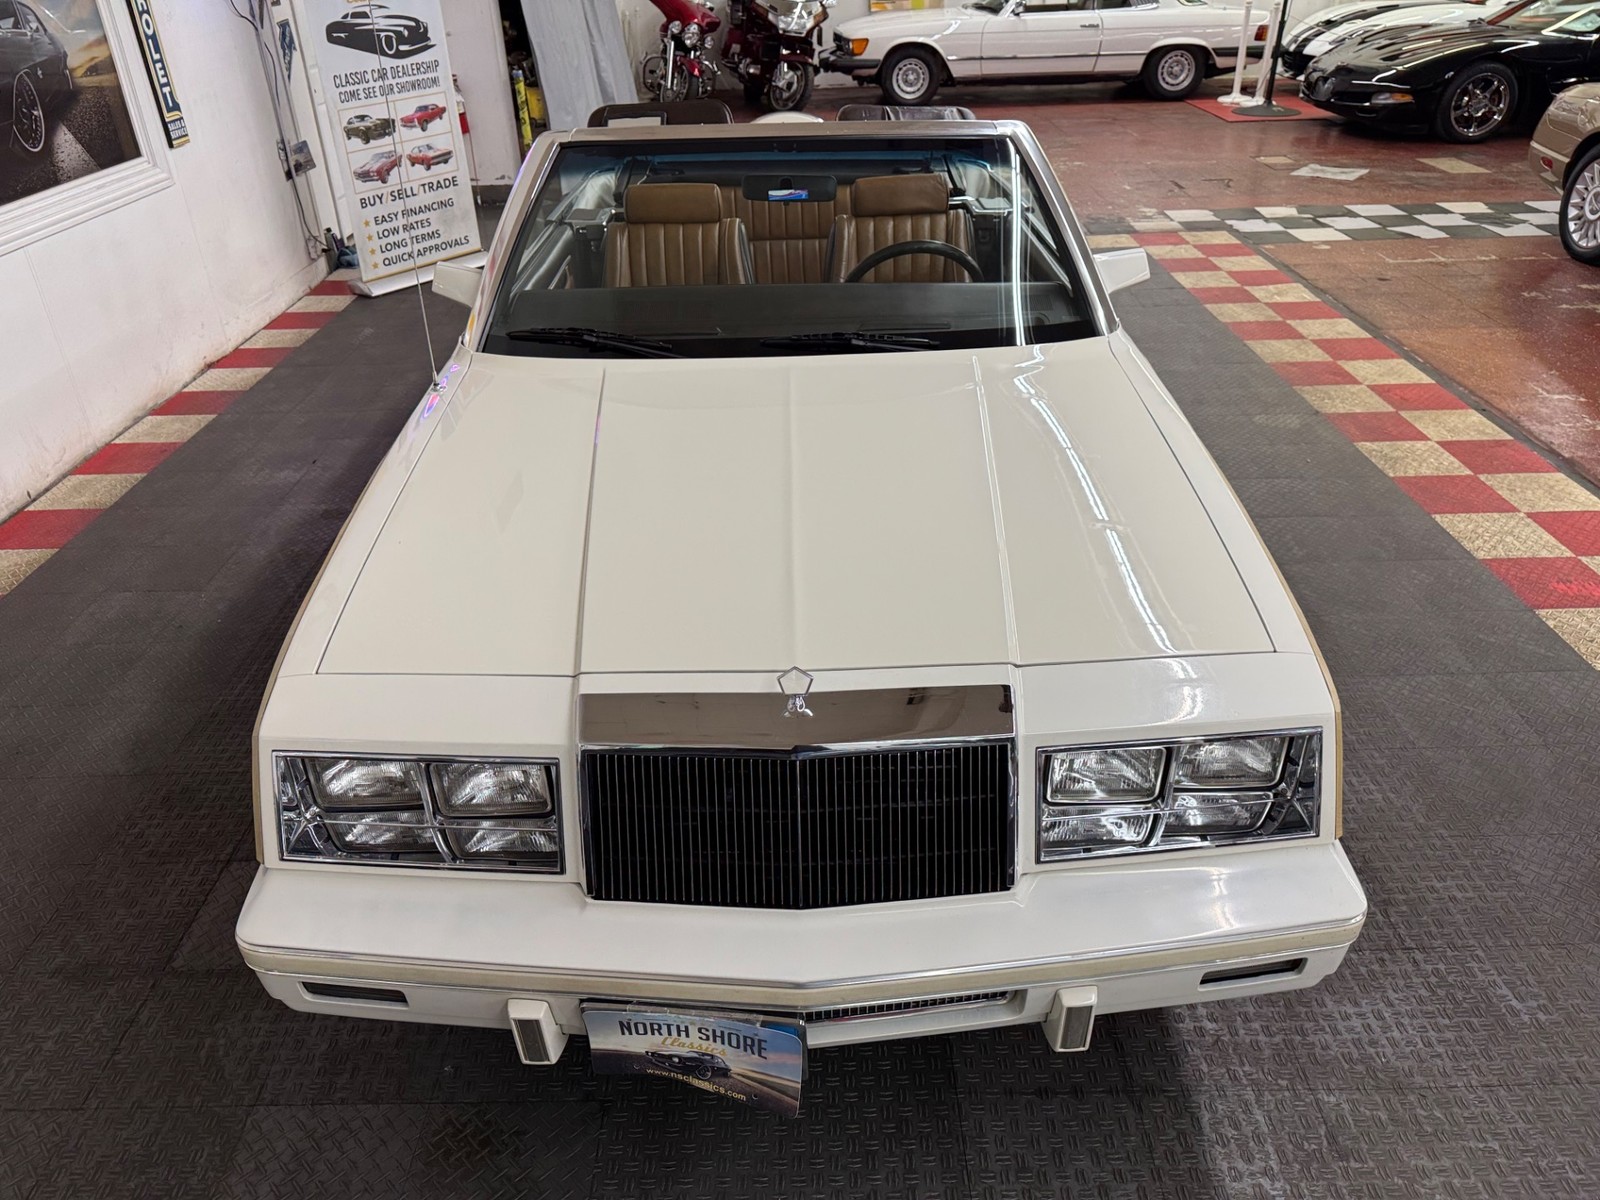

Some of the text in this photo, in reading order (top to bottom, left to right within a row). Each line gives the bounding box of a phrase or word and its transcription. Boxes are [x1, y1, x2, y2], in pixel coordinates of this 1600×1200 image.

[333, 59, 440, 88] CLASSIC CAR DEALERSHIP
[338, 75, 441, 103] COME SEE OUR SHOWROOM!
[374, 198, 454, 226] EASY FINANCING
[376, 218, 432, 240] LOW RATES
[379, 229, 441, 254] LONG TERMS
[382, 235, 470, 267] QUICK APPROVALS
[618, 1020, 768, 1060] NORTH SHORE
[661, 1036, 728, 1057] Classics
[646, 1067, 747, 1101] www.nsclassics.com
